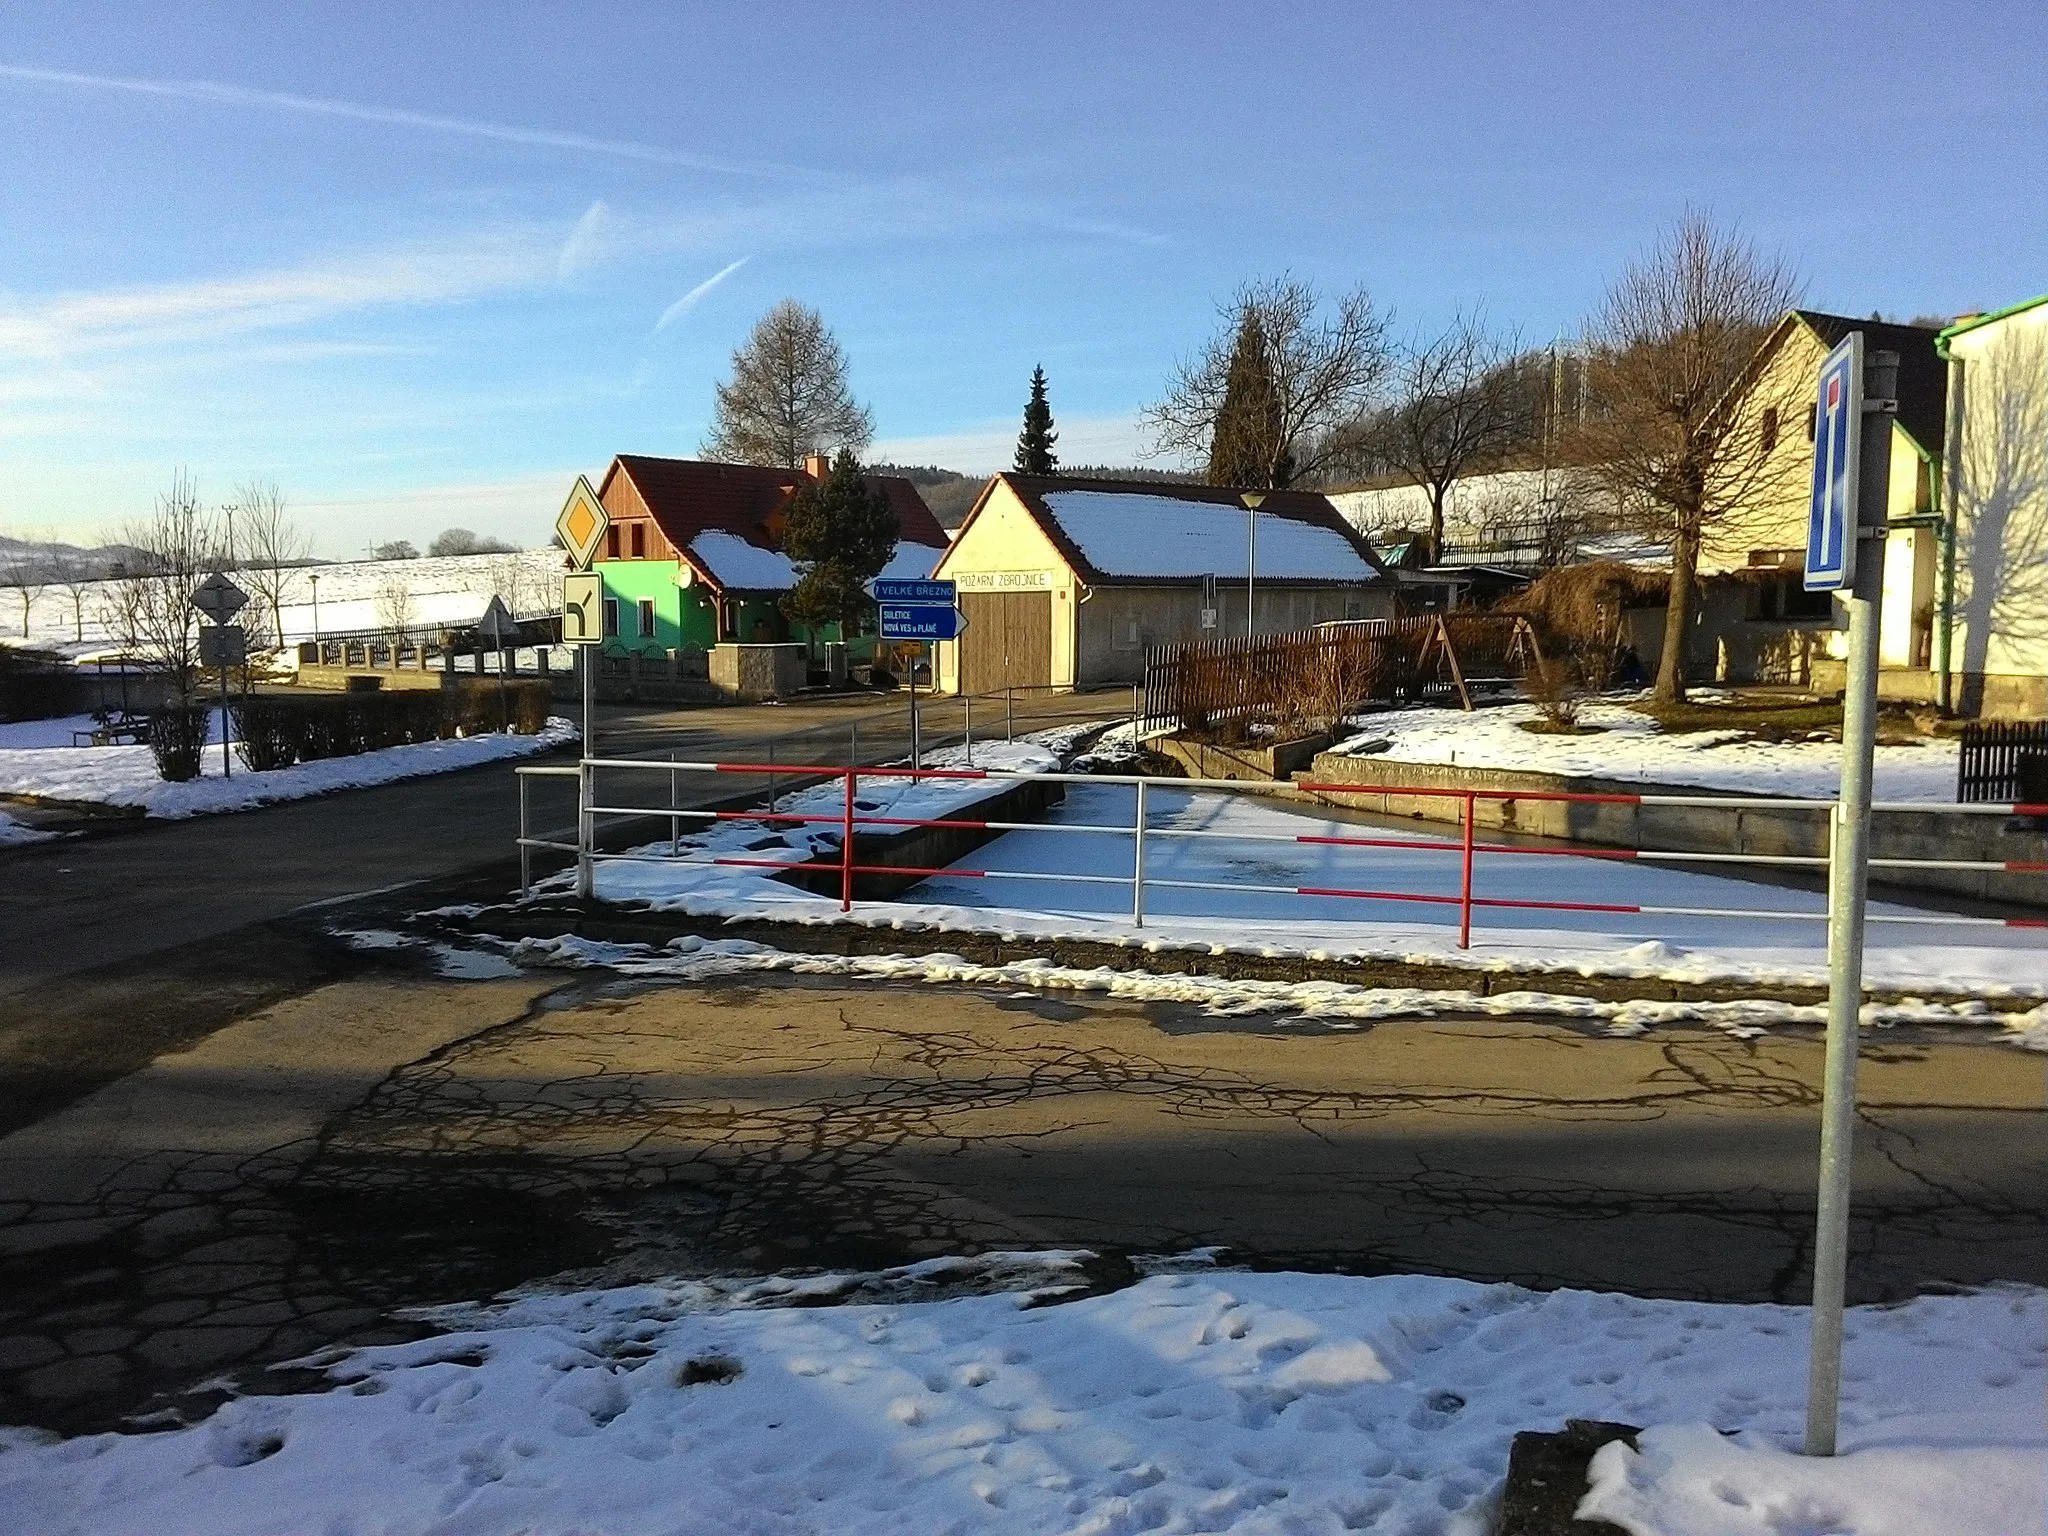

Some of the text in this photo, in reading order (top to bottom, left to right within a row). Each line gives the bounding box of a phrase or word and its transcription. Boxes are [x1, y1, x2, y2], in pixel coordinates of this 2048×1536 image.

[882, 584, 913, 595] VELKÉ
[916, 585, 953, 596] BŘEZNO
[883, 622, 900, 632] NOVÁ
[900, 623, 912, 633] VES
